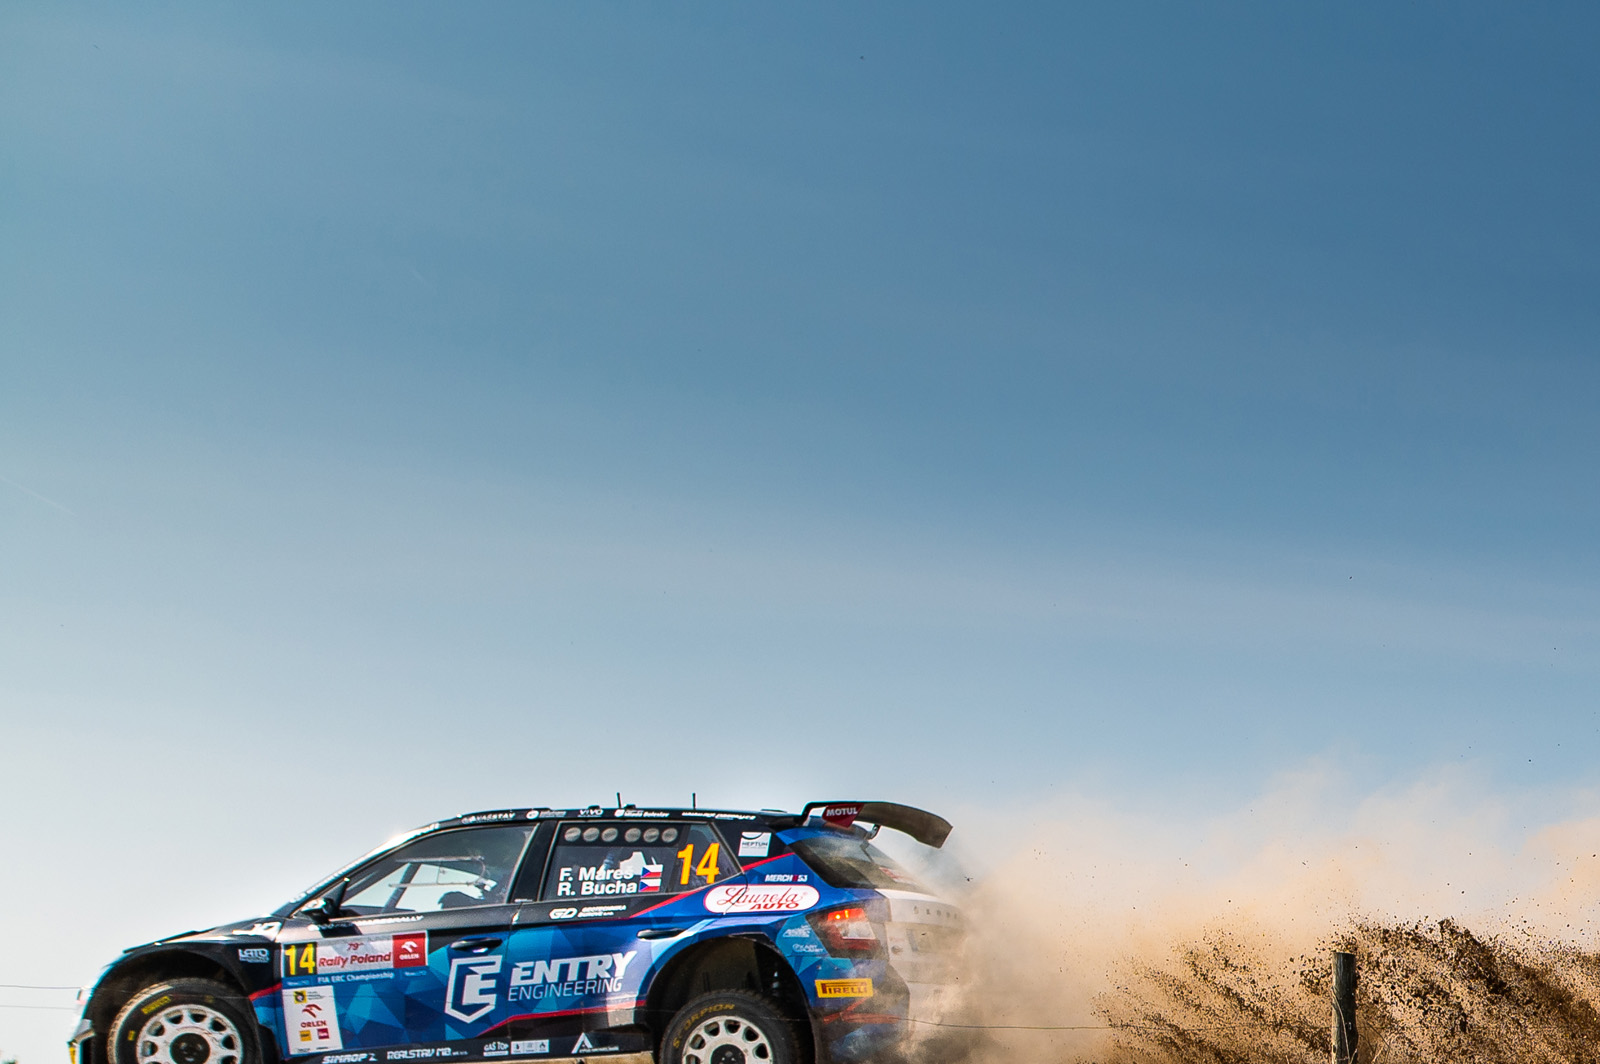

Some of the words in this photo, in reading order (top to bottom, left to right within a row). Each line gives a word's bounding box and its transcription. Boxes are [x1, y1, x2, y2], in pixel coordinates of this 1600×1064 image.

[826, 806, 858, 816] MOTUL
[677, 842, 720, 885] 14
[560, 867, 574, 882] F.
[558, 882, 576, 896] R.
[581, 880, 638, 896] Bucha
[749, 902, 799, 910] AUTO
[284, 944, 316, 976] 14
[319, 957, 348, 968] Rally
[350, 952, 392, 964] Poland
[510, 951, 638, 986] ENTRY
[346, 972, 394, 982] Championship
[508, 976, 624, 1002] ENGINEERING
[822, 981, 868, 994] PIRELLI
[672, 1004, 735, 1048] SORPION
